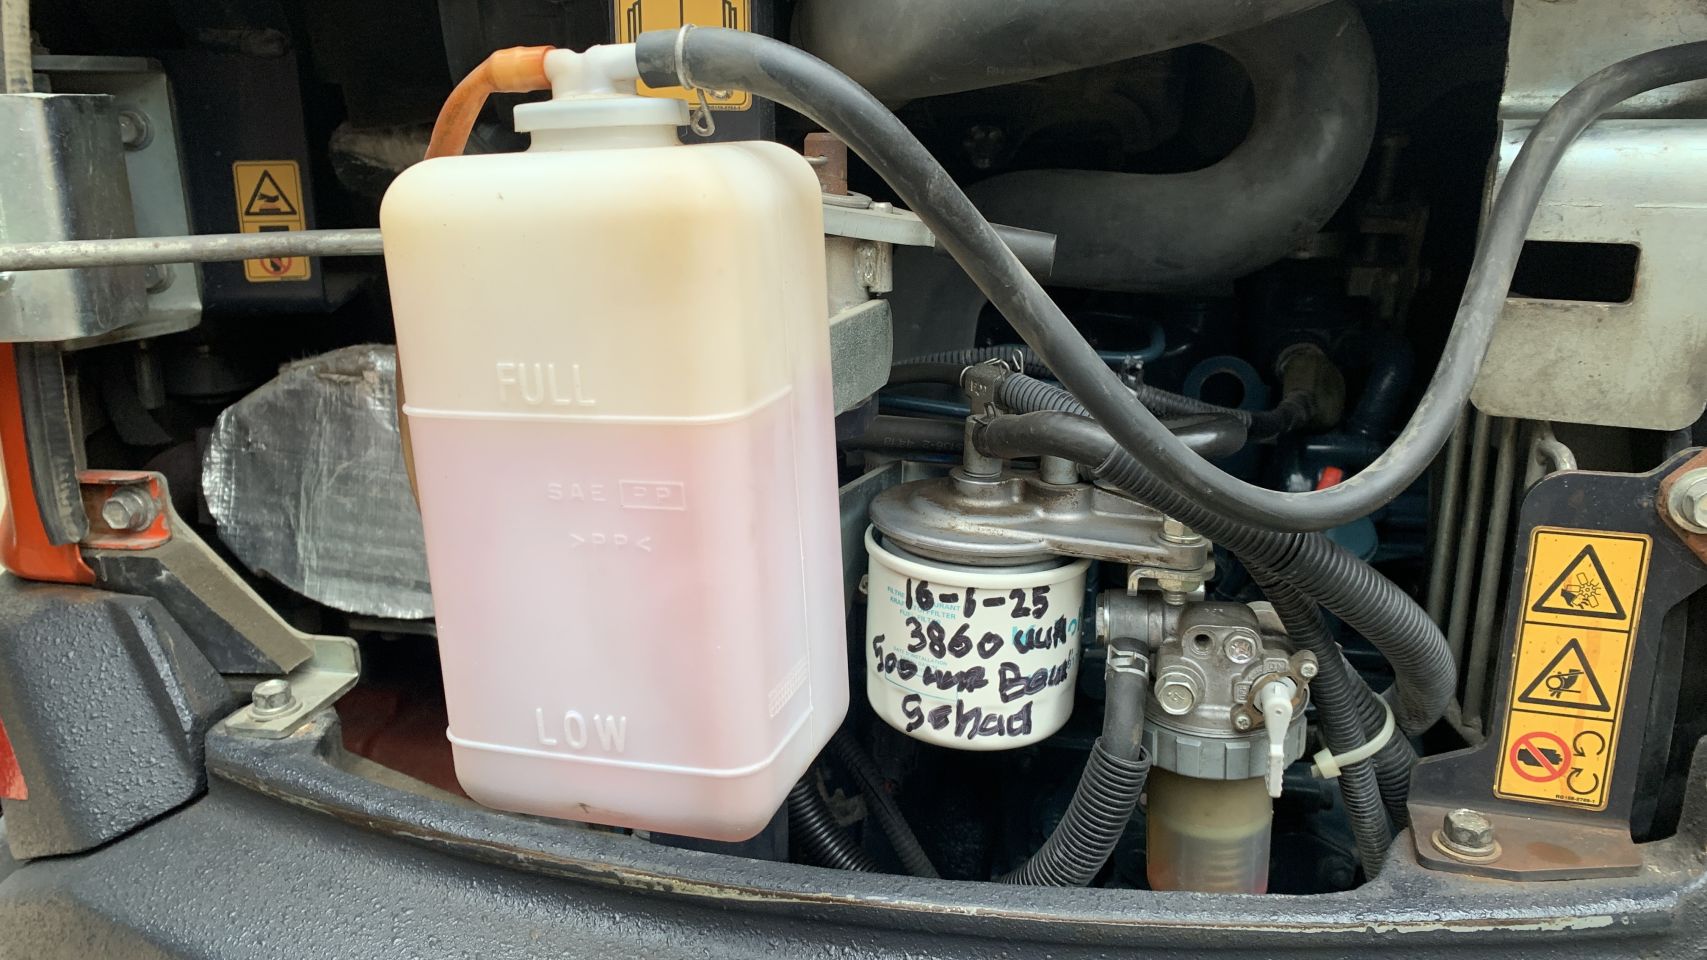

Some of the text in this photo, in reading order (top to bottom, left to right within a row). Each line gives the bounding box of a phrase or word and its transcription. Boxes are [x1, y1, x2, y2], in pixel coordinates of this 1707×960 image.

[496, 362, 597, 404] FULL
[545, 482, 608, 503] SAE
[906, 578, 1051, 619] 16-1-25
[873, 634, 918, 681] 500
[906, 616, 1004, 660] 3860
[536, 706, 627, 752] LOW
